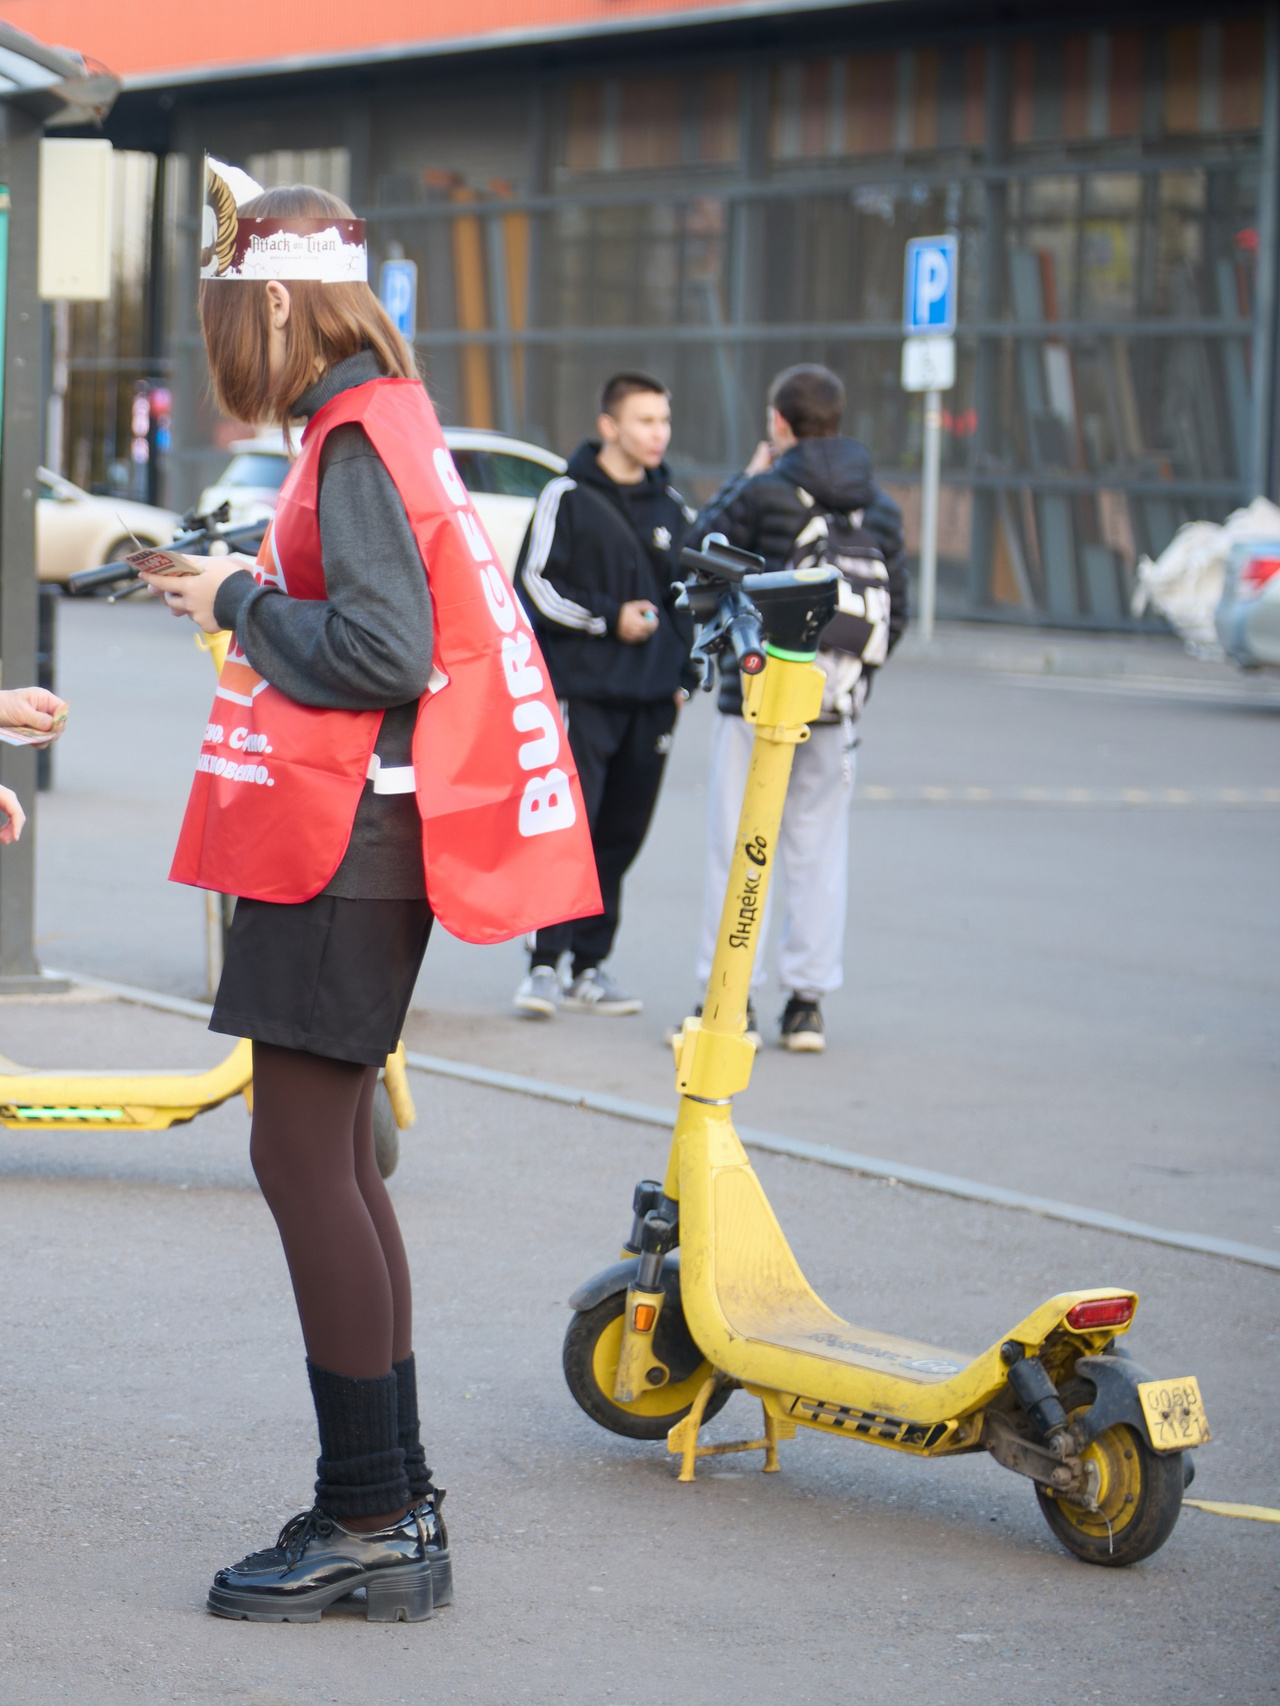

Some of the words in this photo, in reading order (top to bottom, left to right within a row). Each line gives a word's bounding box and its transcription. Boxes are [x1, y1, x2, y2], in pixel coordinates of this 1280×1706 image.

[251, 234, 291, 254] Attack
[293, 241, 304, 250] on
[305, 235, 336, 253] Titan
[916, 248, 948, 326] P
[433, 447, 577, 838] BURGER
[748, 656, 759, 669] Я
[729, 873, 761, 949] Яндекс
[745, 835, 768, 867] Go
